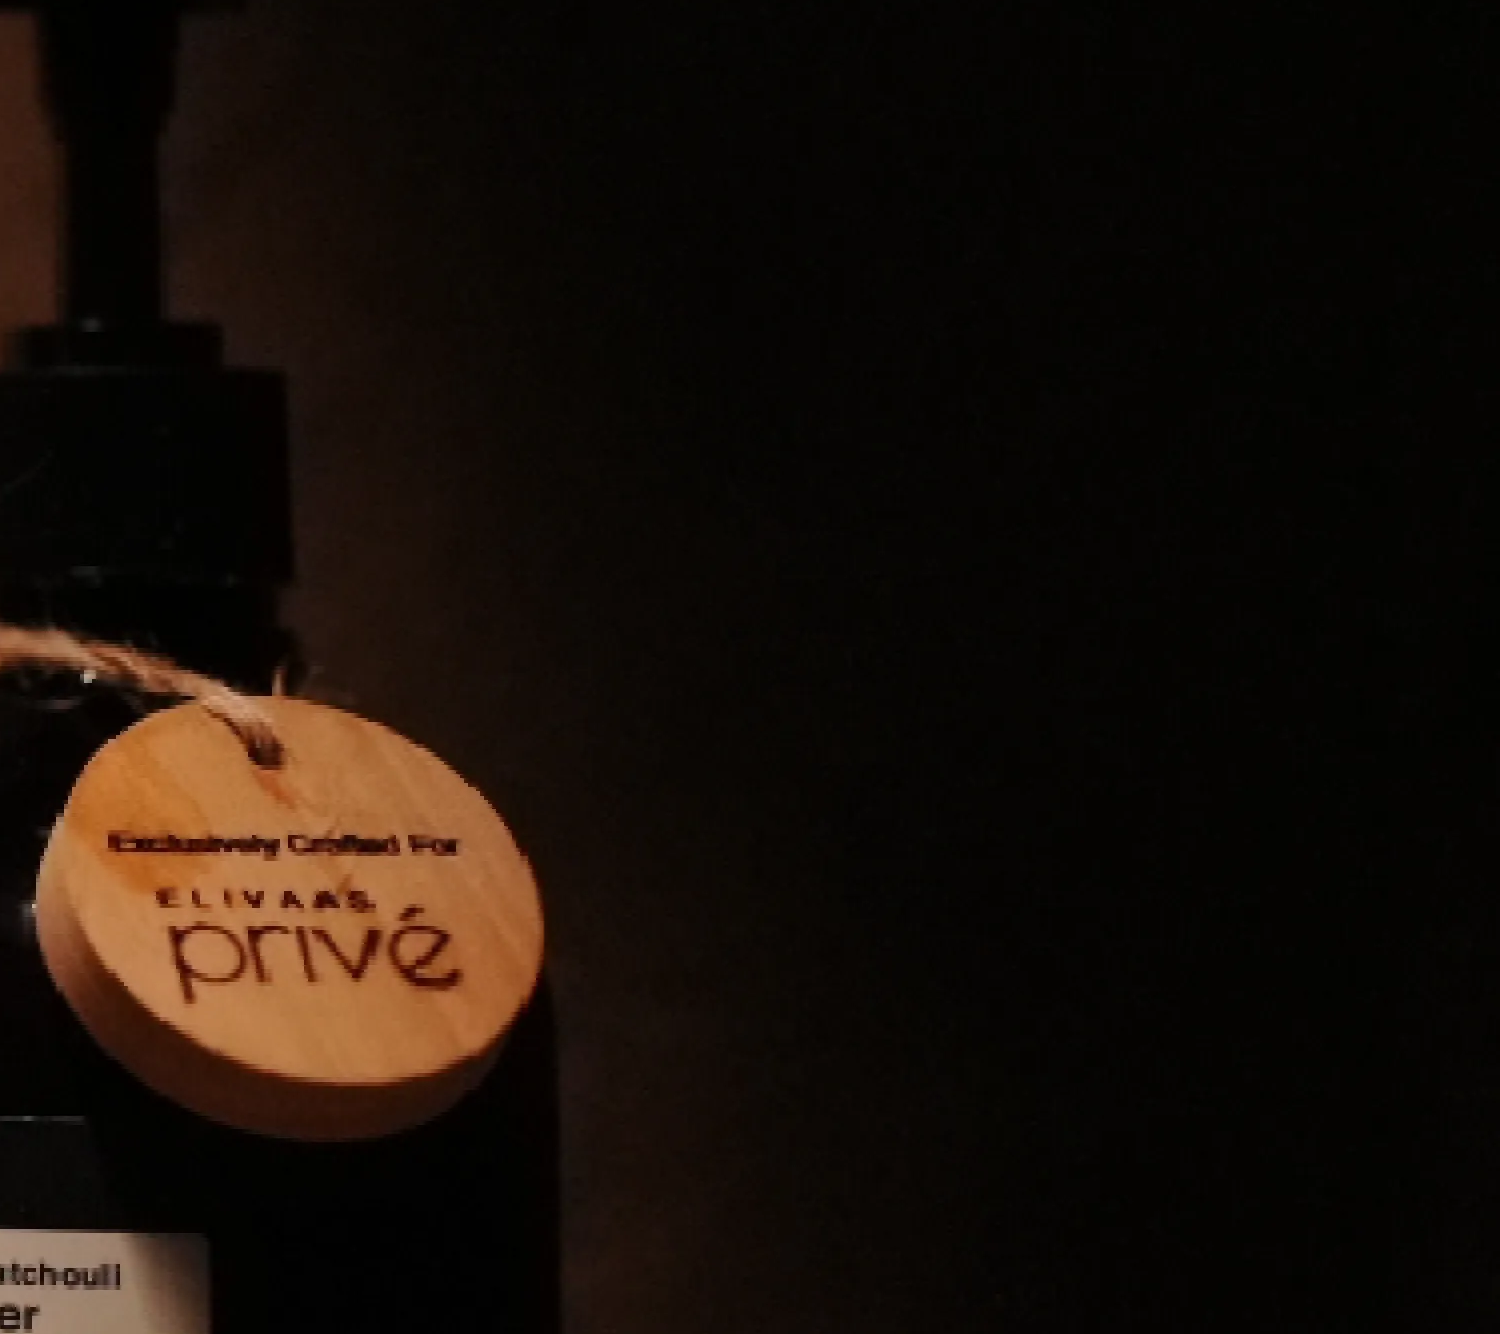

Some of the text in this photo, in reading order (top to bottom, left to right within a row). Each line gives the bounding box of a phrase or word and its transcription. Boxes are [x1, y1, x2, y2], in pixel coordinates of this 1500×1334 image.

[107, 830, 461, 860] Exclusively Crafted For
[155, 888, 377, 910] ELIVAAS
[167, 904, 464, 1004] privé
